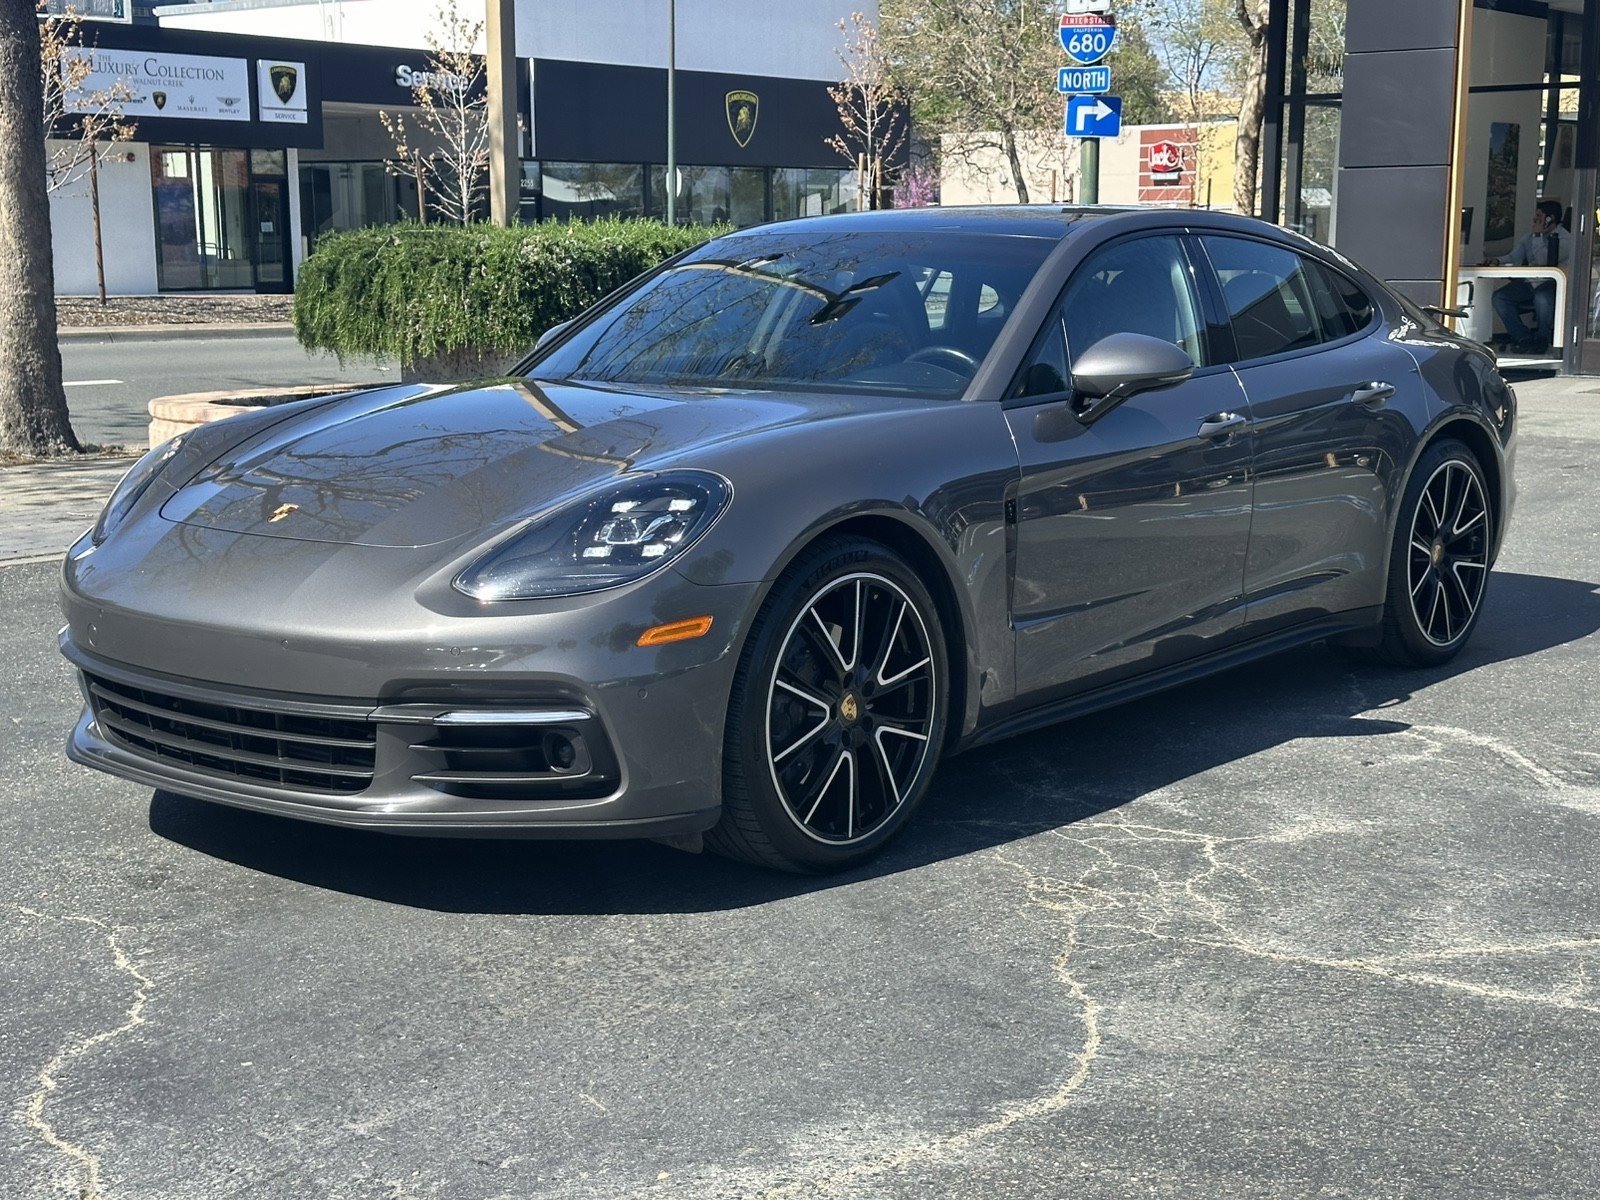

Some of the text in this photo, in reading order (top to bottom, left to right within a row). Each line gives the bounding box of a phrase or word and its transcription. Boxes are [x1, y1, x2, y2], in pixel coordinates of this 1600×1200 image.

[1068, 33, 1106, 54] 680
[144, 58, 224, 80] COLLECTION
[133, 78, 184, 88] WALNUT CREEK
[1062, 71, 1106, 89] NORTH
[177, 105, 208, 113] MASERATI
[275, 112, 296, 120] SERVICE
